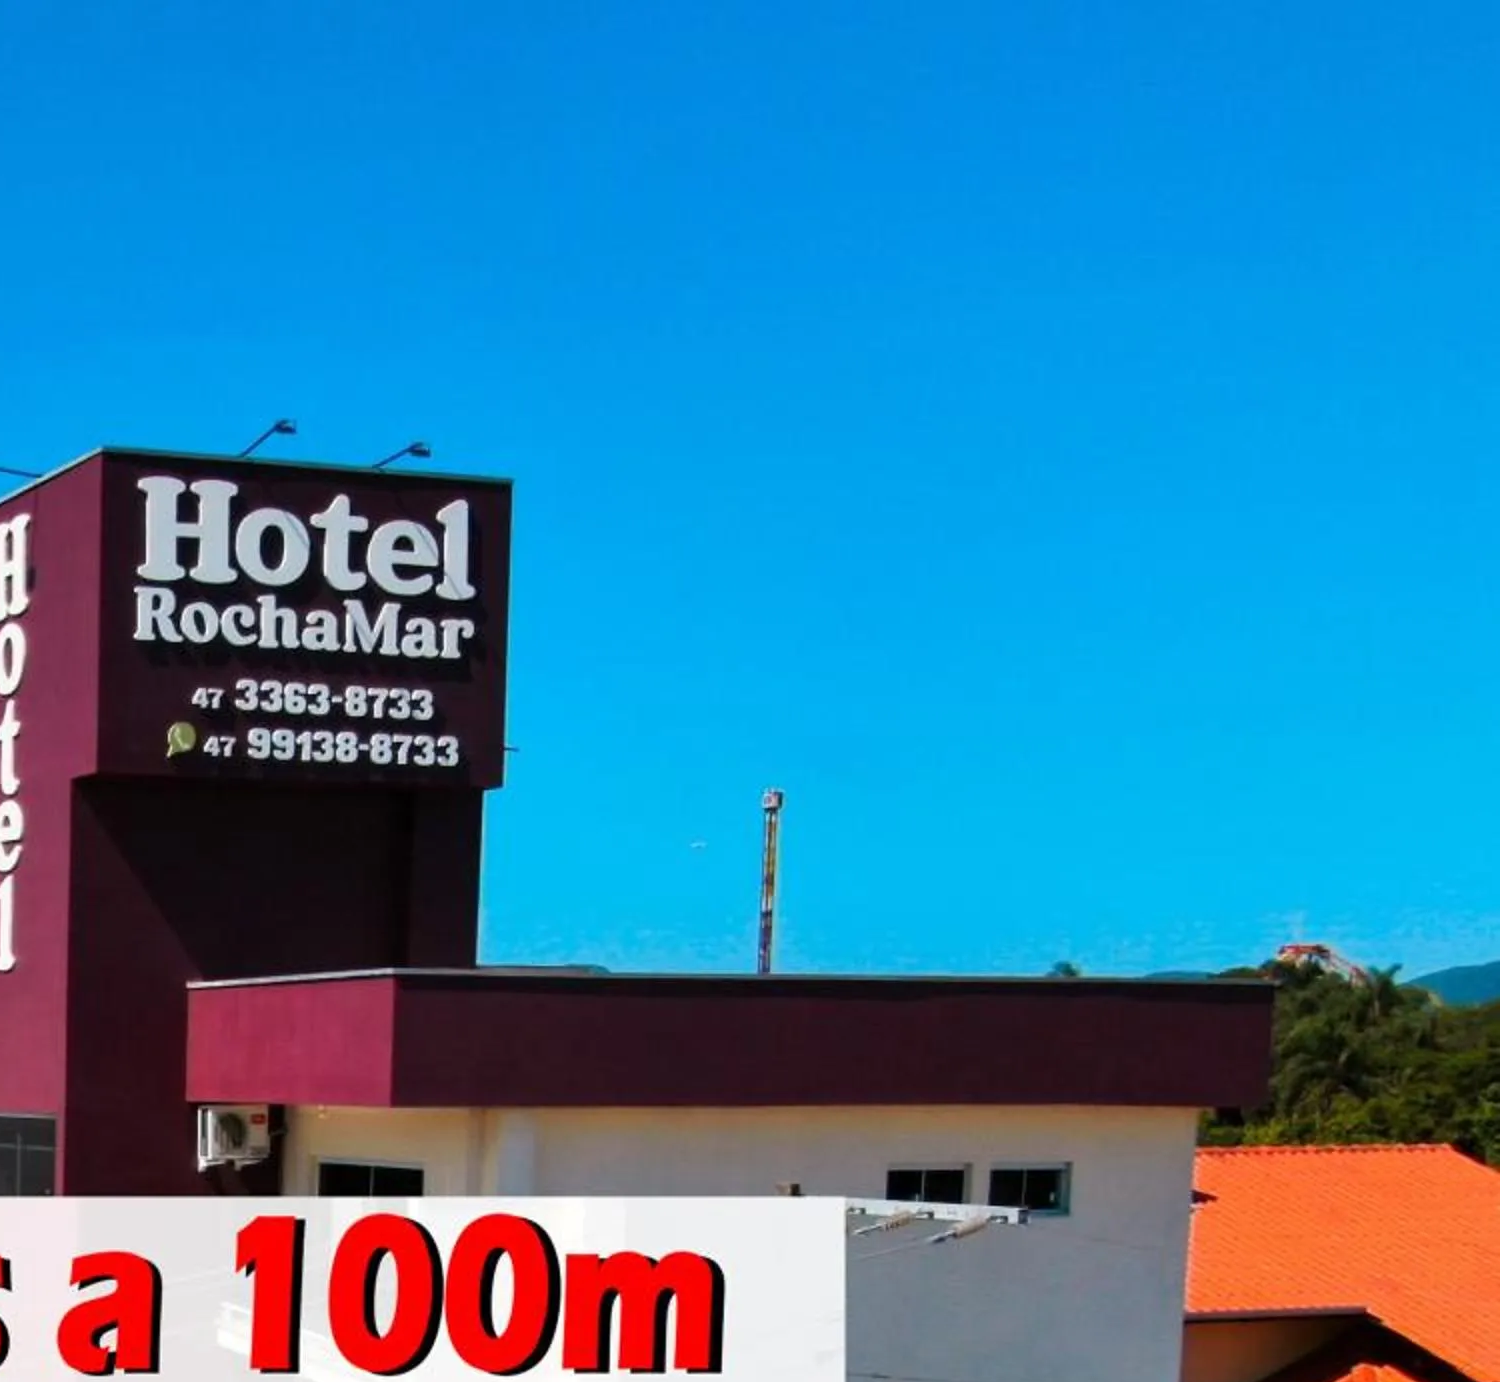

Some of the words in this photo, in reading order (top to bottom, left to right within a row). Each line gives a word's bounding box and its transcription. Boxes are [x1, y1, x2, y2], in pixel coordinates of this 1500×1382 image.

[136, 475, 476, 601] Hotel
[133, 585, 475, 659] RochaMar
[191, 687, 224, 709] 47
[234, 678, 434, 721] 3363-8733
[203, 735, 236, 758] 47
[247, 727, 460, 768] 99138-8733
